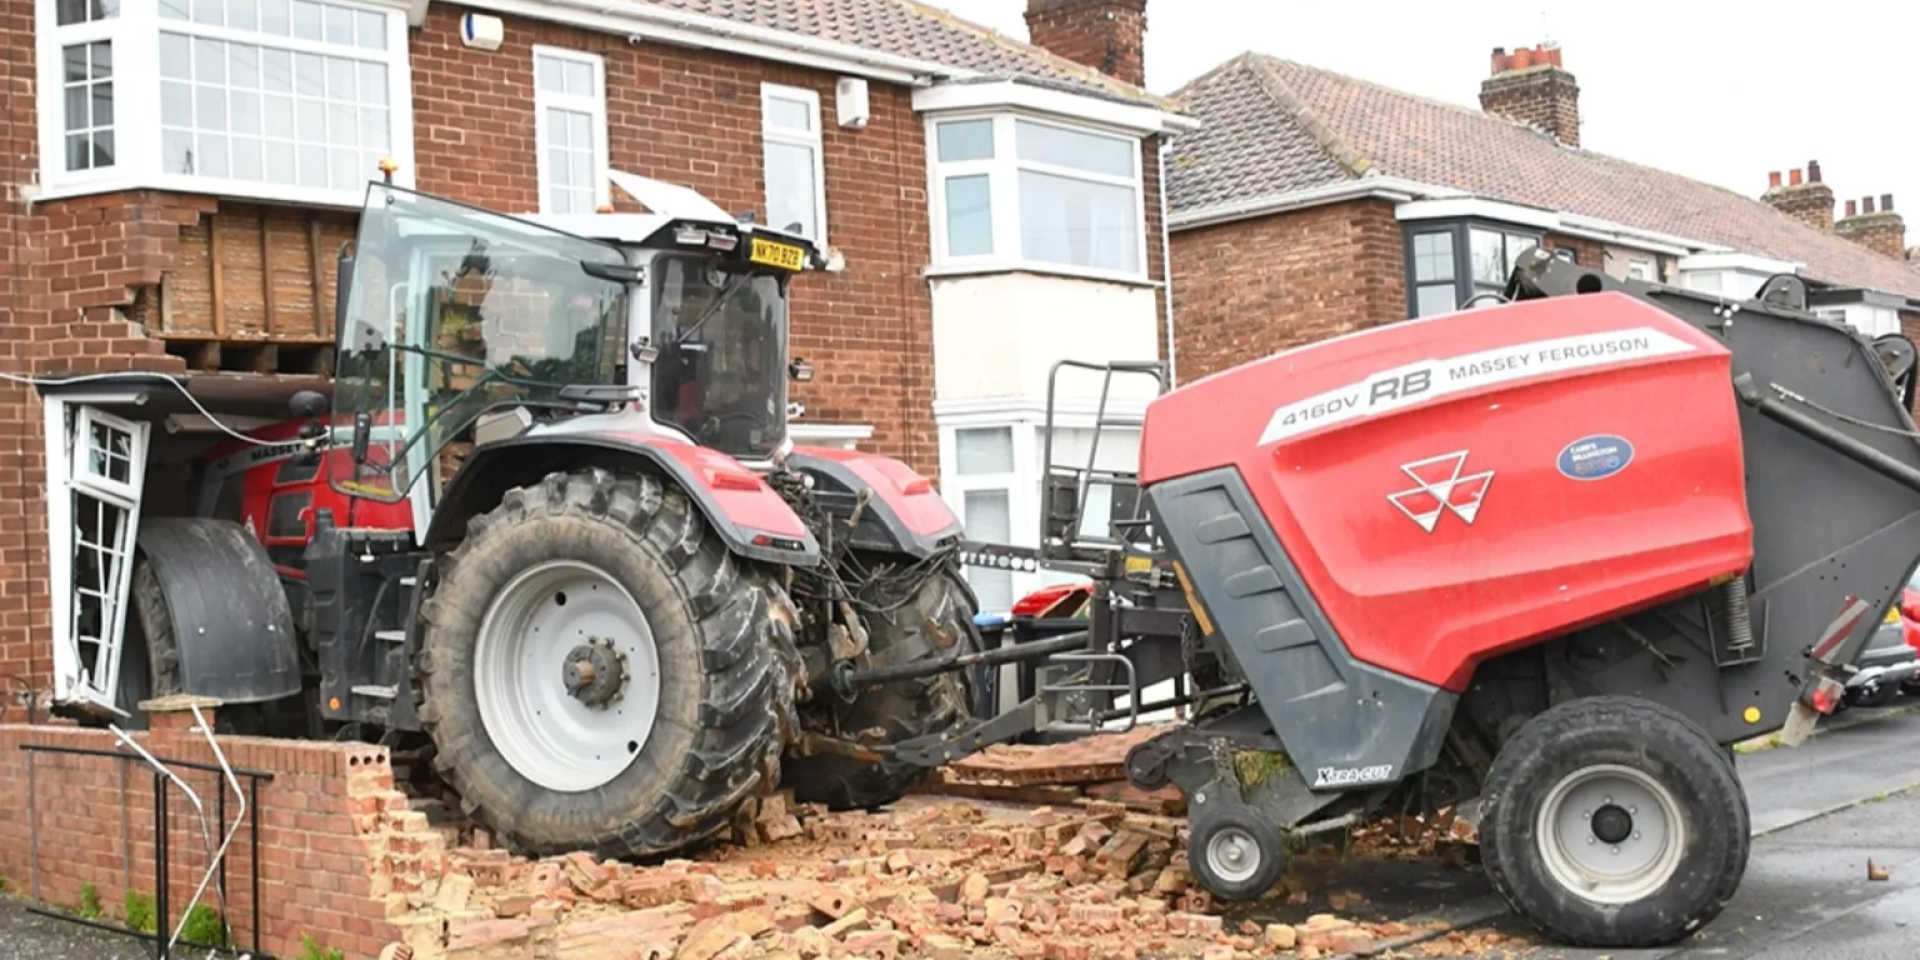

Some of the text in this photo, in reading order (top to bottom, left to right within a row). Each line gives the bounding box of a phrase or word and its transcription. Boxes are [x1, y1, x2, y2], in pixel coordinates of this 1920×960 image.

[756, 242, 799, 266] NK70 BZB
[1282, 337, 1650, 426] 4160V RB MASSEY FERGUSON
[250, 444, 301, 461] MASSEY
